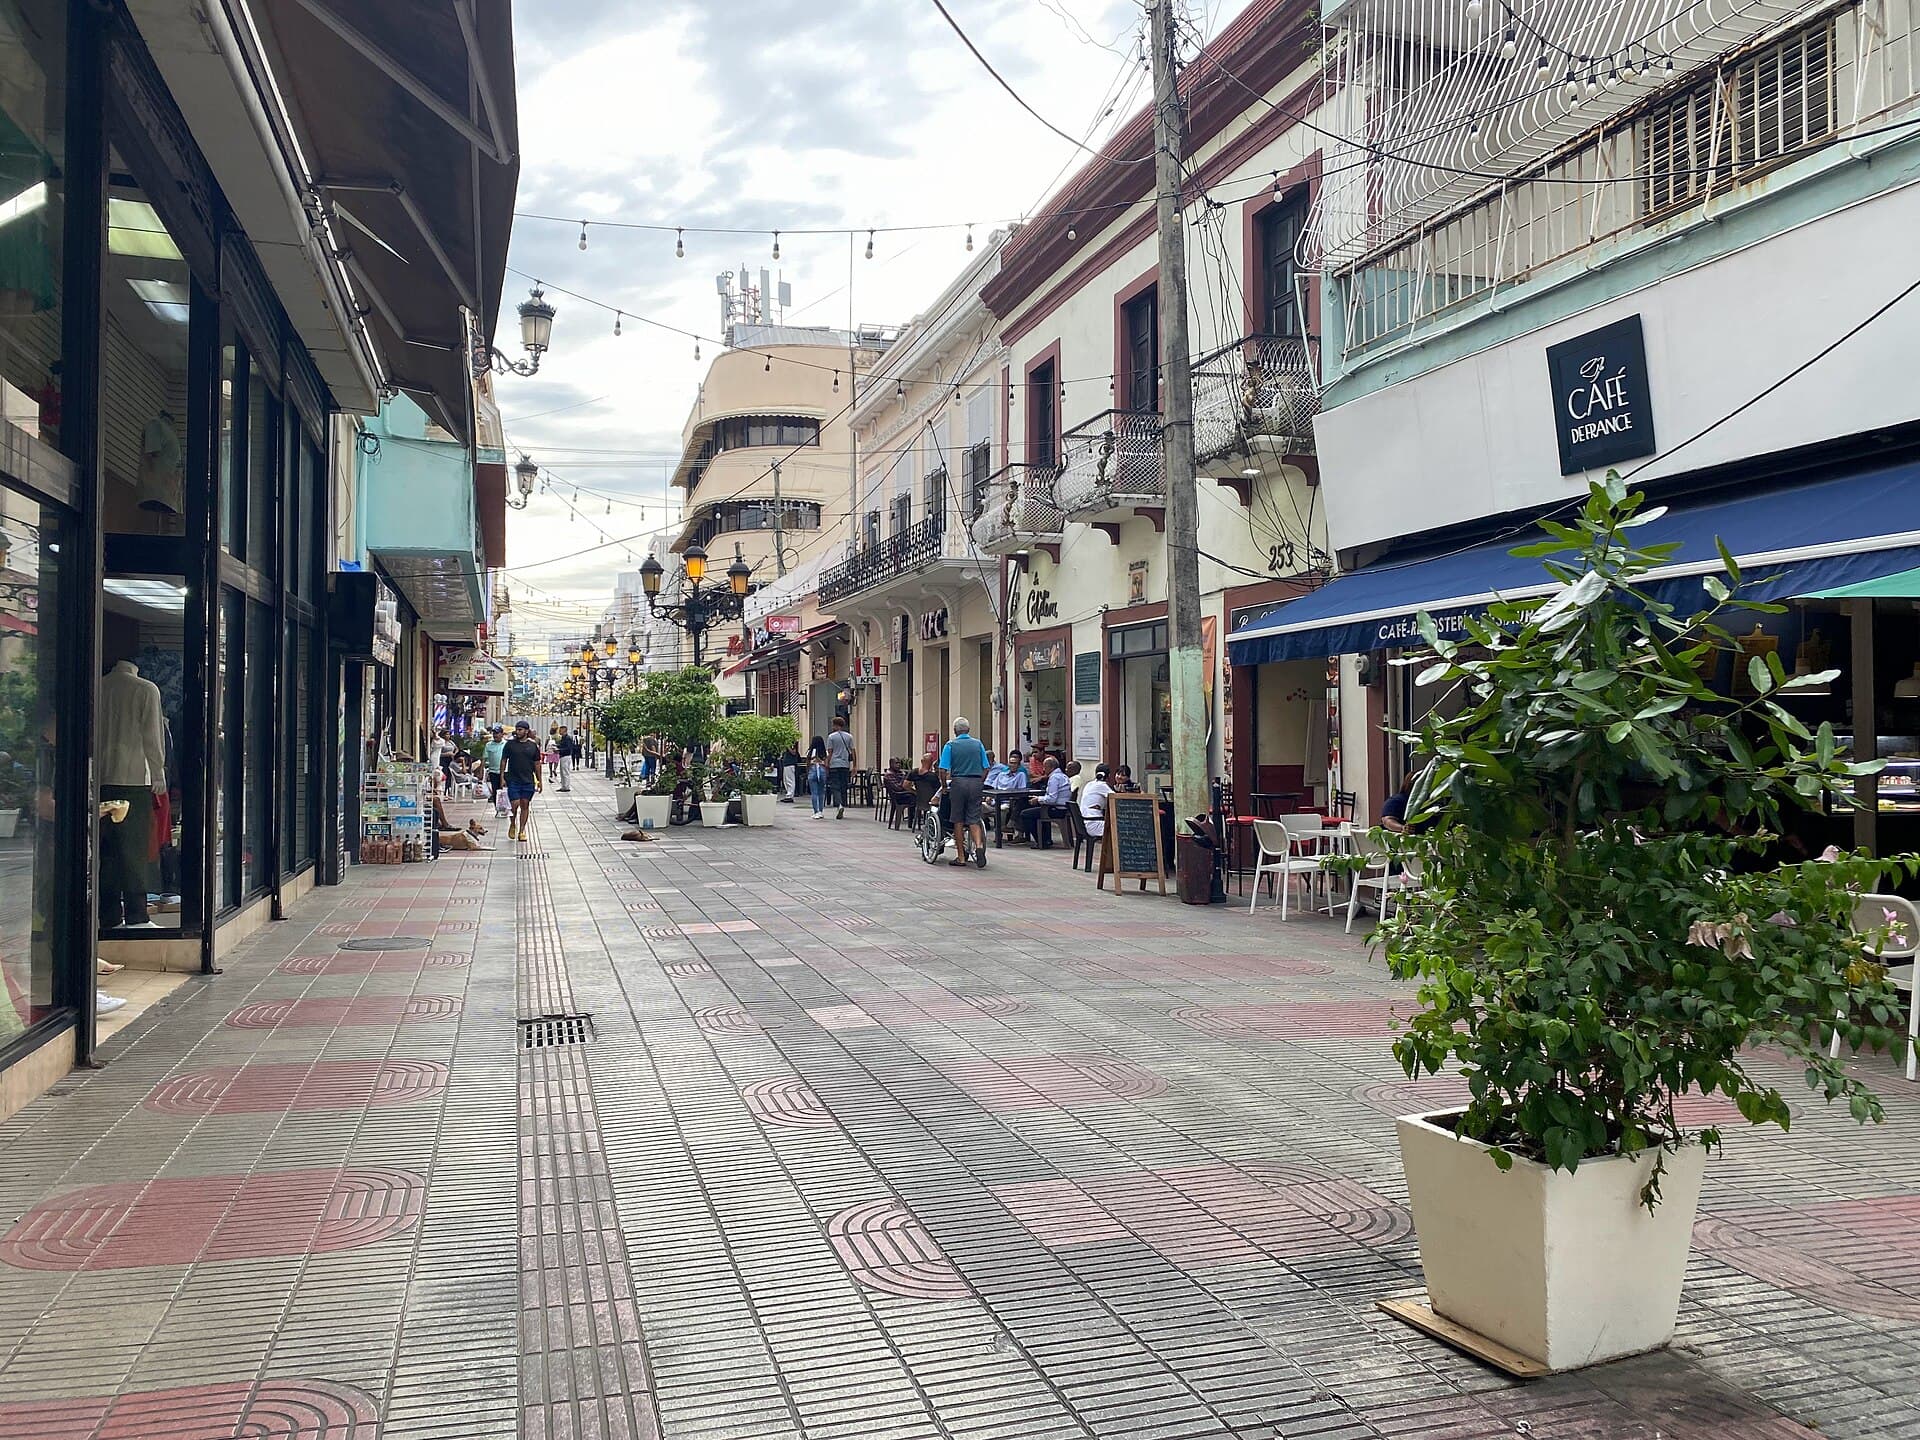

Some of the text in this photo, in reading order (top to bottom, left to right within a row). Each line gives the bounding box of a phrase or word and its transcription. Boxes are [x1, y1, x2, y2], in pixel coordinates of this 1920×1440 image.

[1568, 366, 1630, 420] CAFÉ
[1268, 542, 1294, 571] 253
[919, 608, 944, 640] KFC
